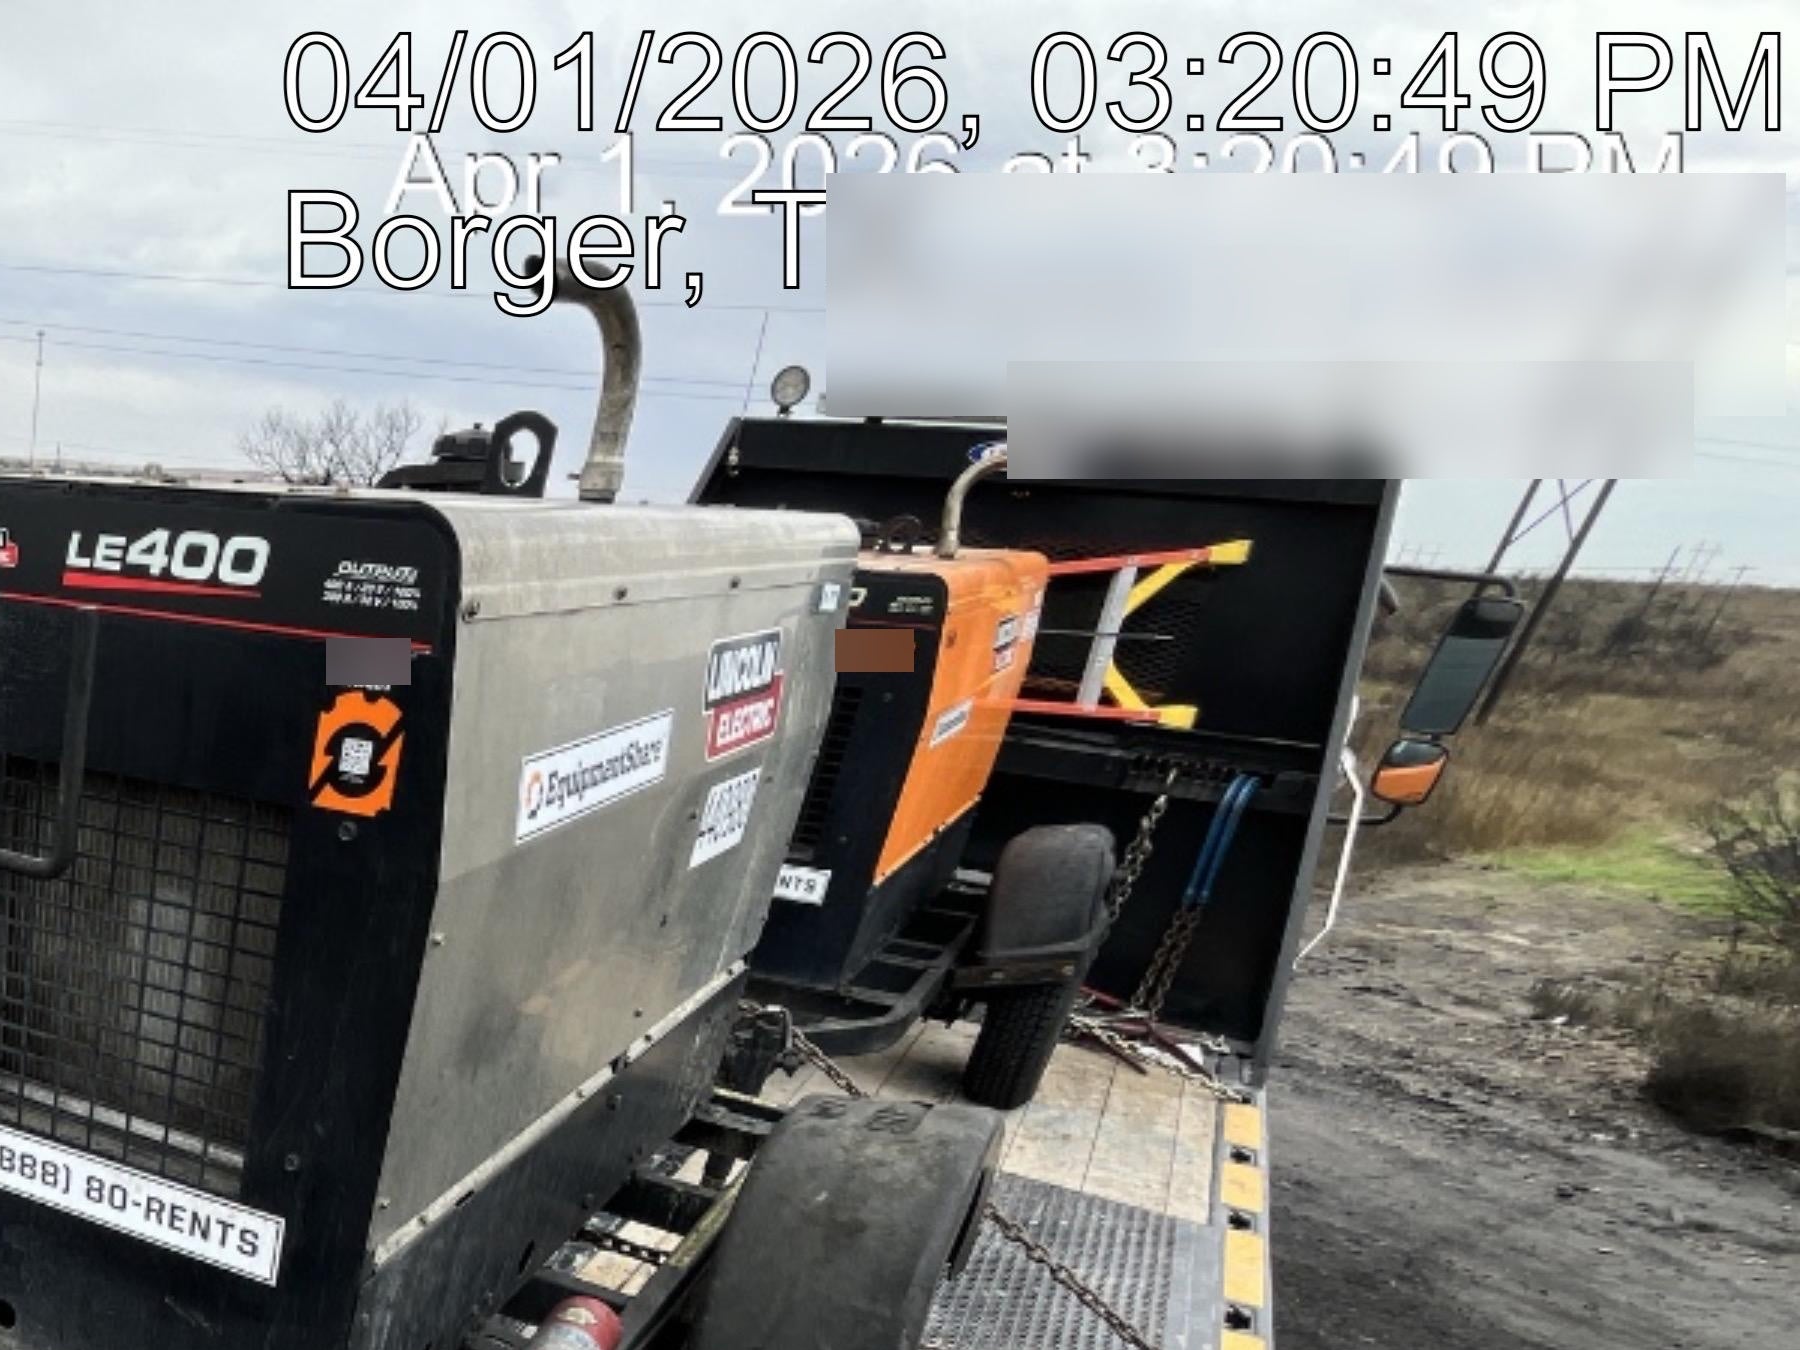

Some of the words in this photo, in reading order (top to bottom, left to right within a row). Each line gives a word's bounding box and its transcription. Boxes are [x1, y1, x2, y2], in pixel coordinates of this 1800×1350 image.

[65, 527, 272, 586] LE400
[707, 640, 779, 702] LINCOLN
[716, 697, 776, 748] ELECTRIC
[545, 739, 664, 811] EquipmentShare
[86, 1174, 261, 1259] 80-RENTS
